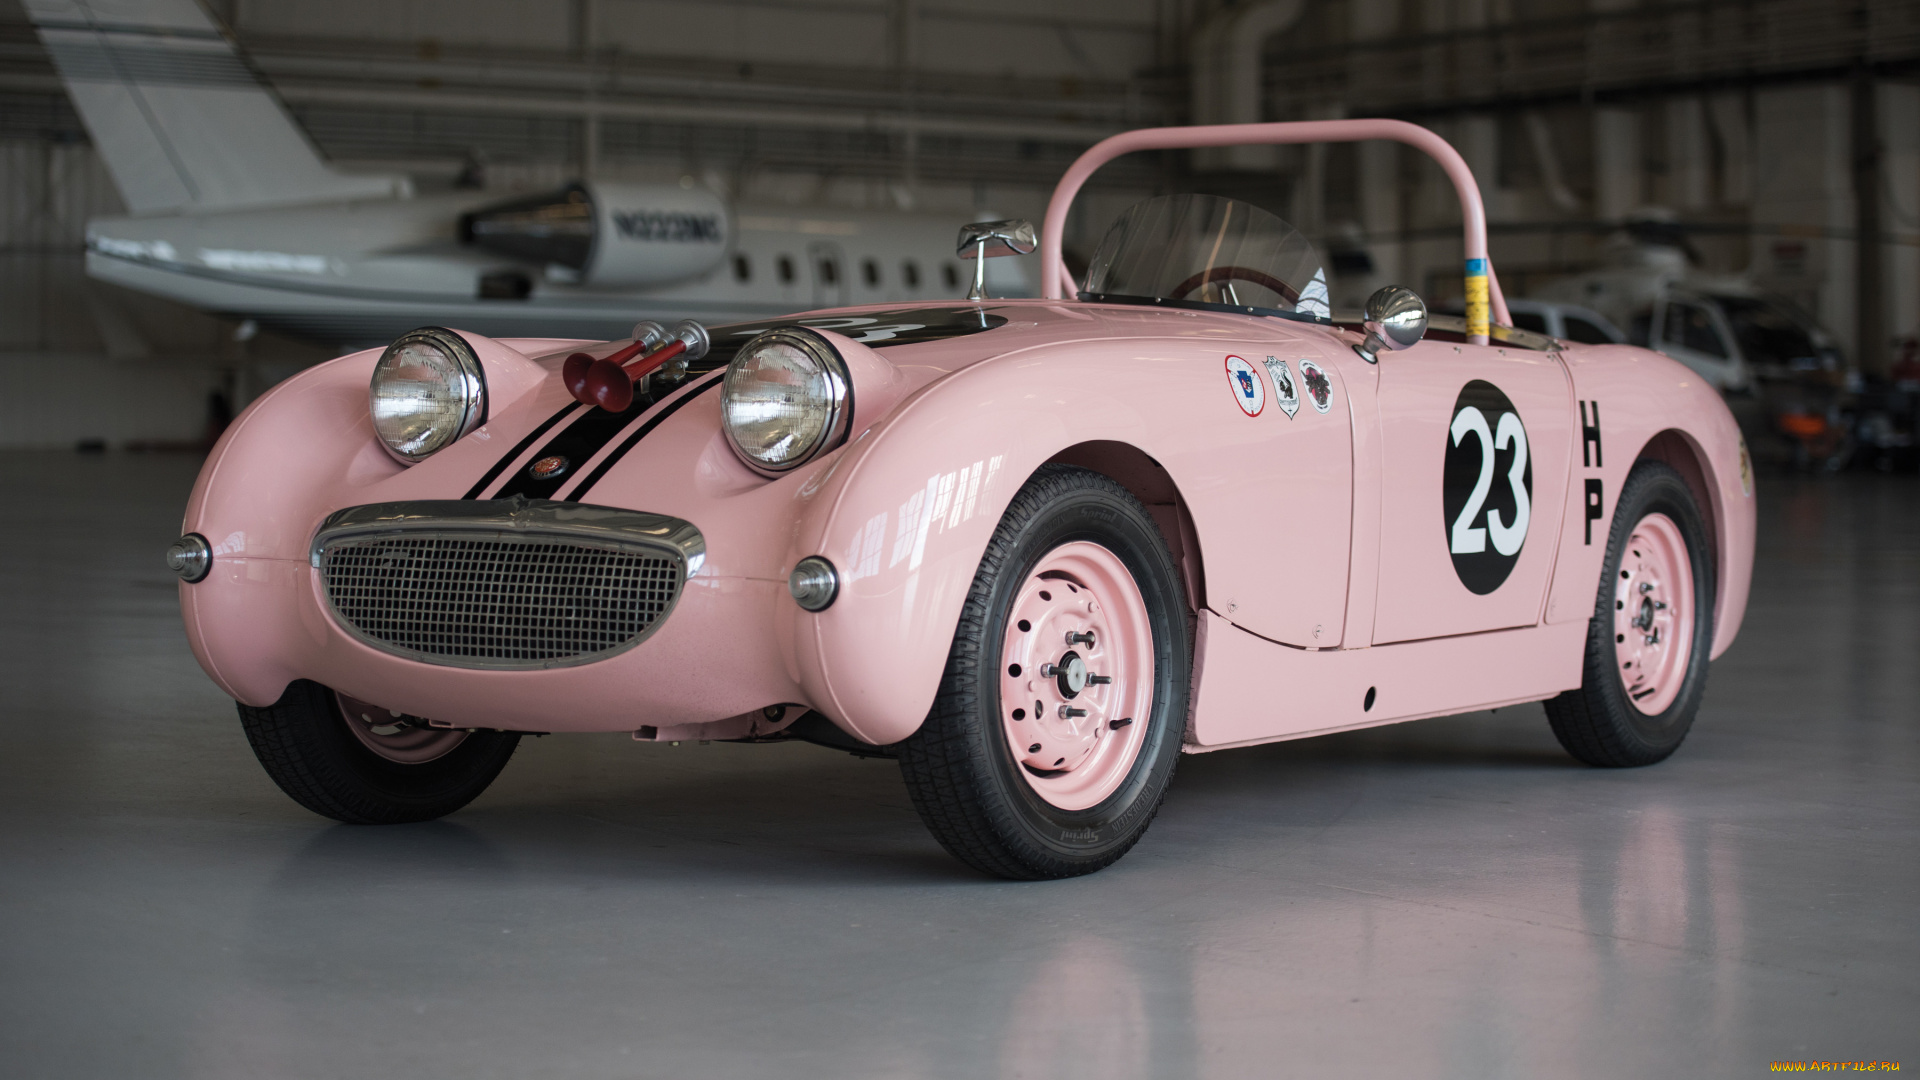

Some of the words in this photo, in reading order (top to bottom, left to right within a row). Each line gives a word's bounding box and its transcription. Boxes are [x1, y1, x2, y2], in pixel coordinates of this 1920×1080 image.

[1450, 406, 1531, 557] 23
[1111, 783, 1154, 834] VREDESTEIN
[1060, 828, 1099, 843] Sprint
